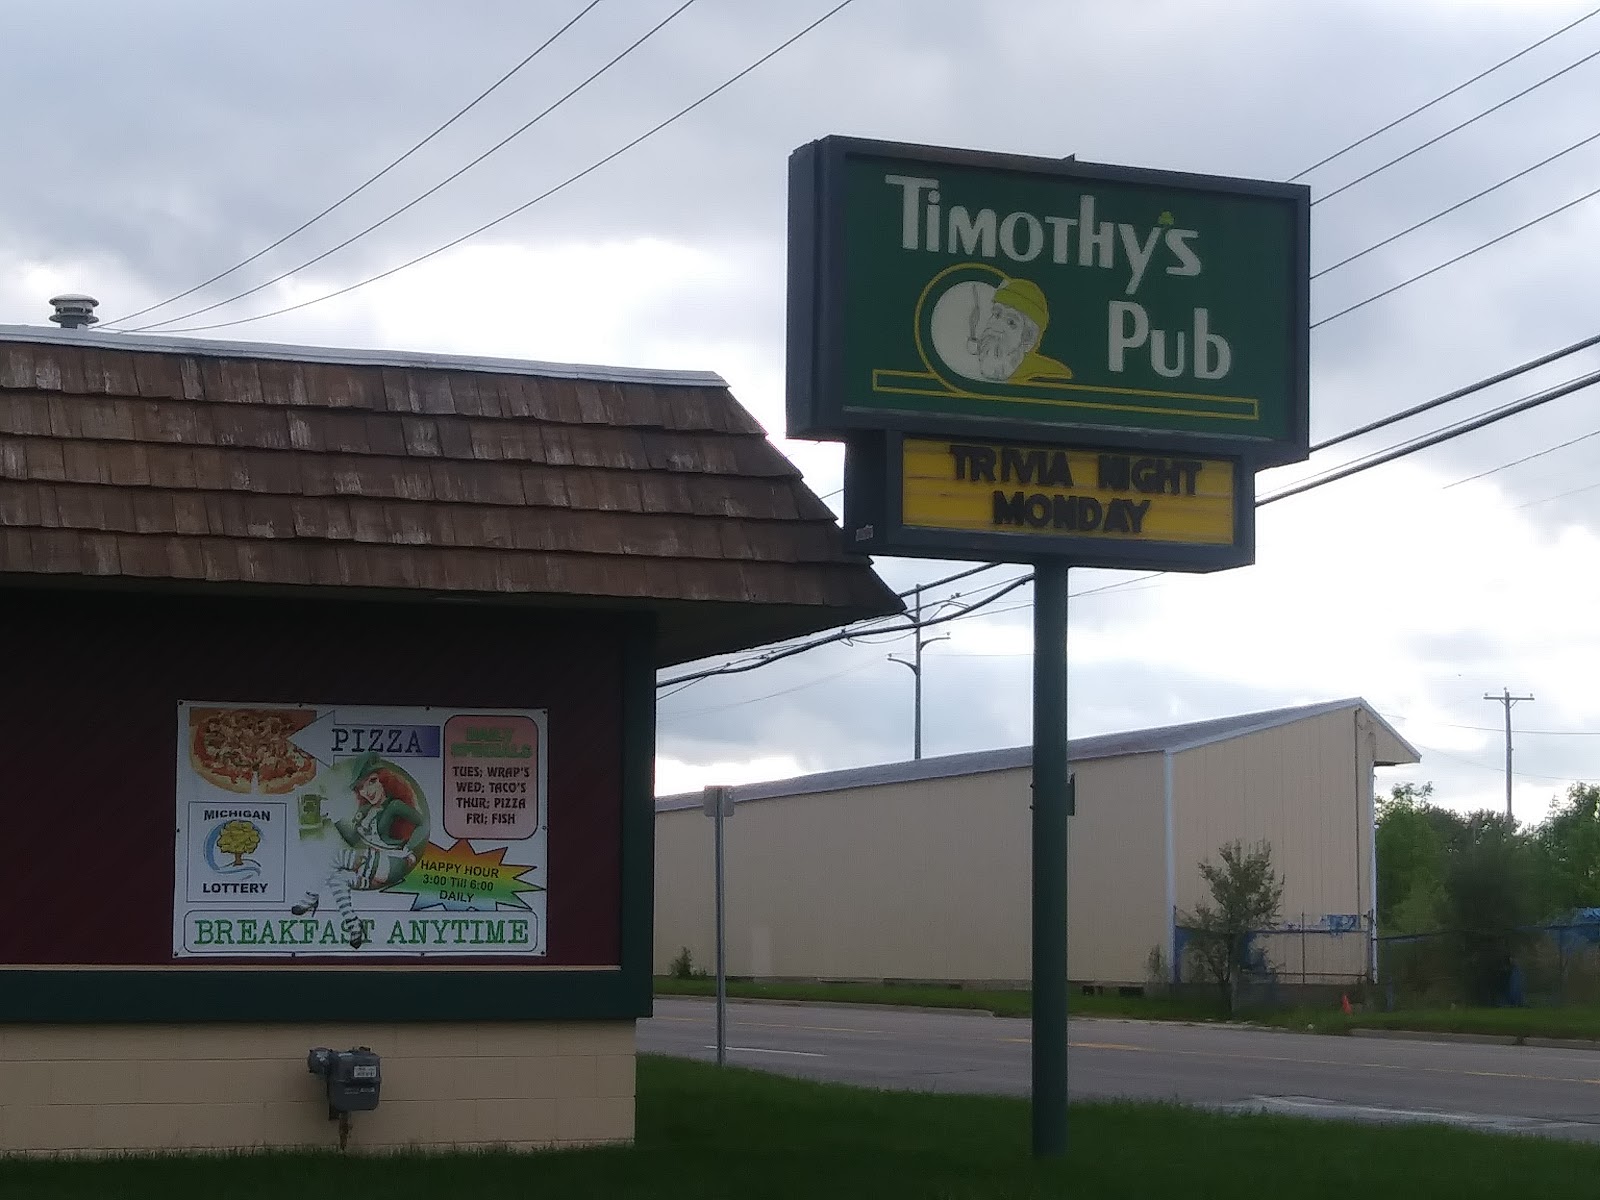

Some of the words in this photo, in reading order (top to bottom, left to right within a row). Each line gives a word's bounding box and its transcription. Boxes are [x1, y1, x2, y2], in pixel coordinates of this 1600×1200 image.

[1107, 300, 1232, 380] Pub
[947, 445, 1074, 489] TRIVIA
[1097, 453, 1203, 496] NIGHT
[992, 490, 1151, 533] MONDAY
[330, 727, 423, 754] PIZZA
[487, 767, 530, 778] WRAP'S
[489, 783, 526, 793] TACO'S
[495, 798, 526, 809] PIZZA
[204, 809, 271, 821] MICHIGAN
[492, 813, 516, 824] FISH
[420, 860, 462, 874] HAPPY
[464, 865, 500, 879] HOUR
[203, 882, 269, 894] LOTTERY
[422, 874, 447, 886] 3:00
[470, 879, 494, 891] 6:00
[439, 890, 475, 903] DAILY
[193, 918, 376, 946] BREAKFAST
[386, 918, 530, 945] ANYTIME
